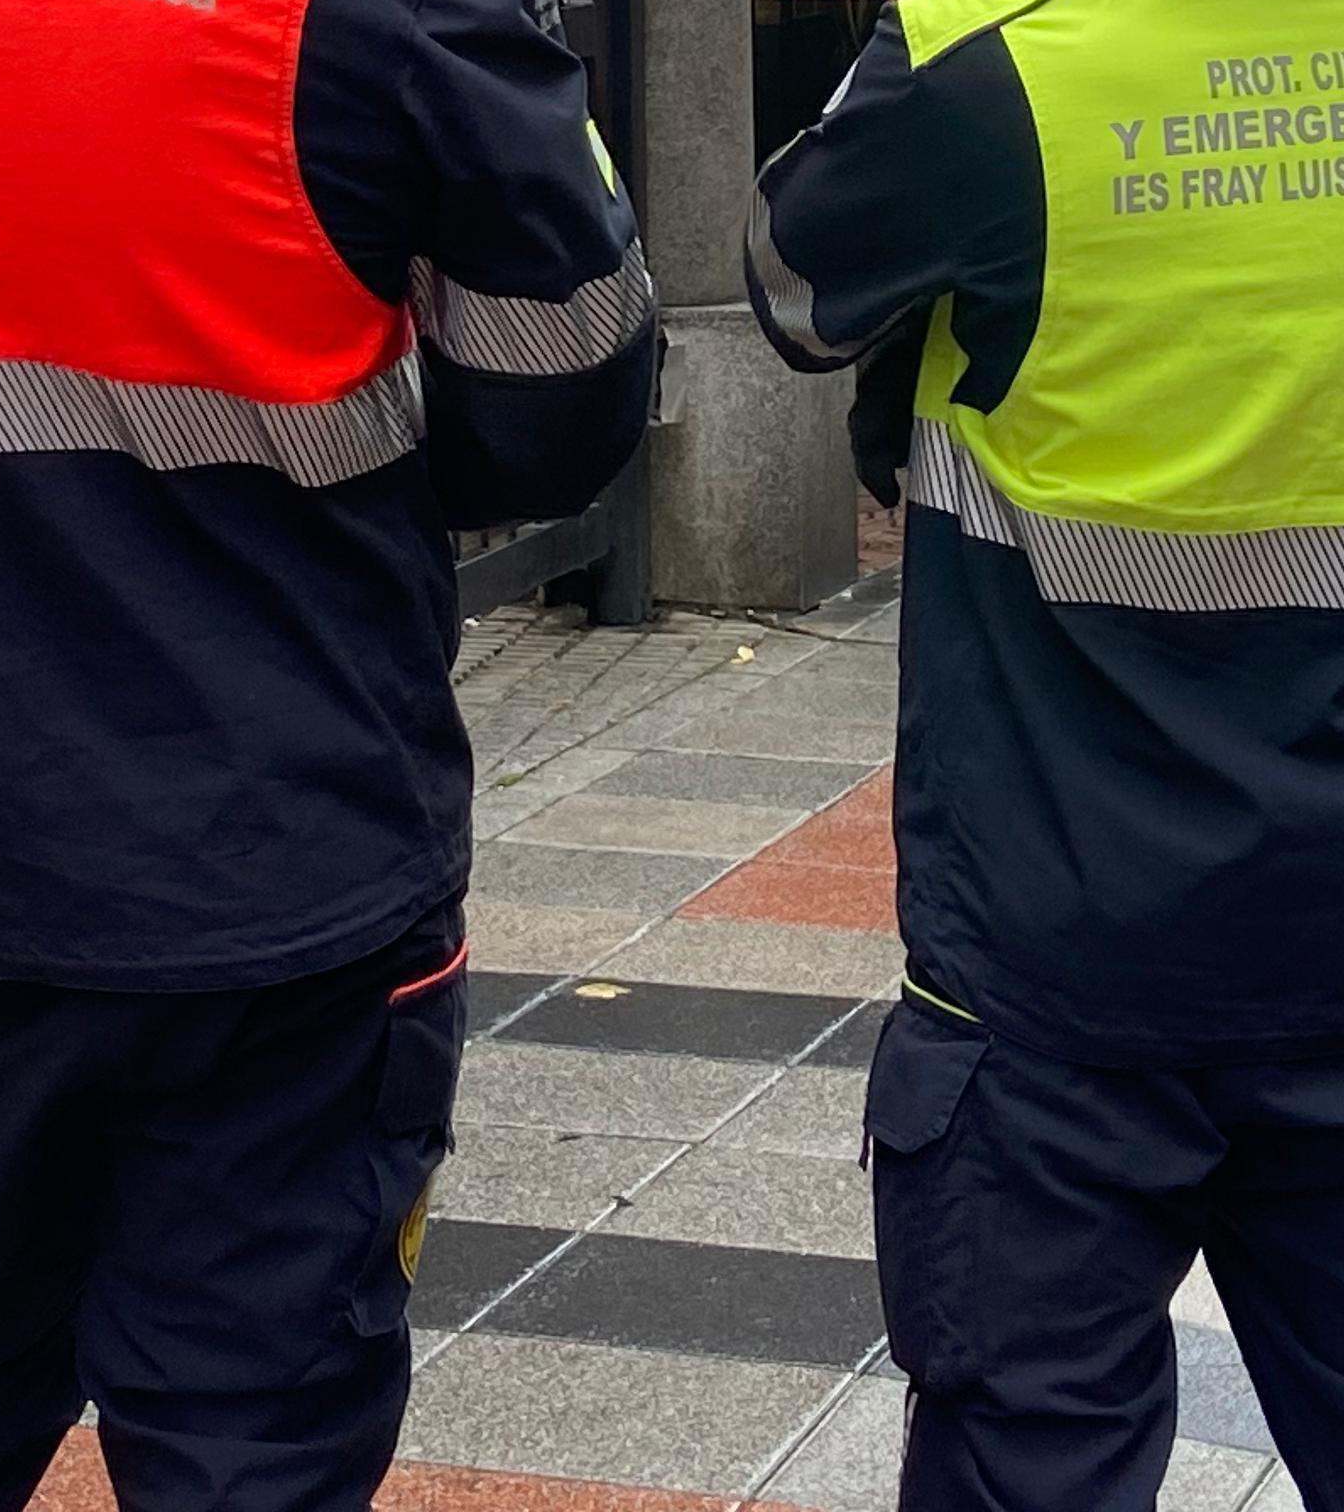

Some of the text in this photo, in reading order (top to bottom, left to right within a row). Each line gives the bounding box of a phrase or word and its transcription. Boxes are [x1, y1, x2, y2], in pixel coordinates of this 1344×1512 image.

[1205, 55, 1302, 99] PROT.
[1109, 119, 1146, 161] Y
[1113, 171, 1170, 216] IES
[1181, 163, 1268, 210] FRAY
